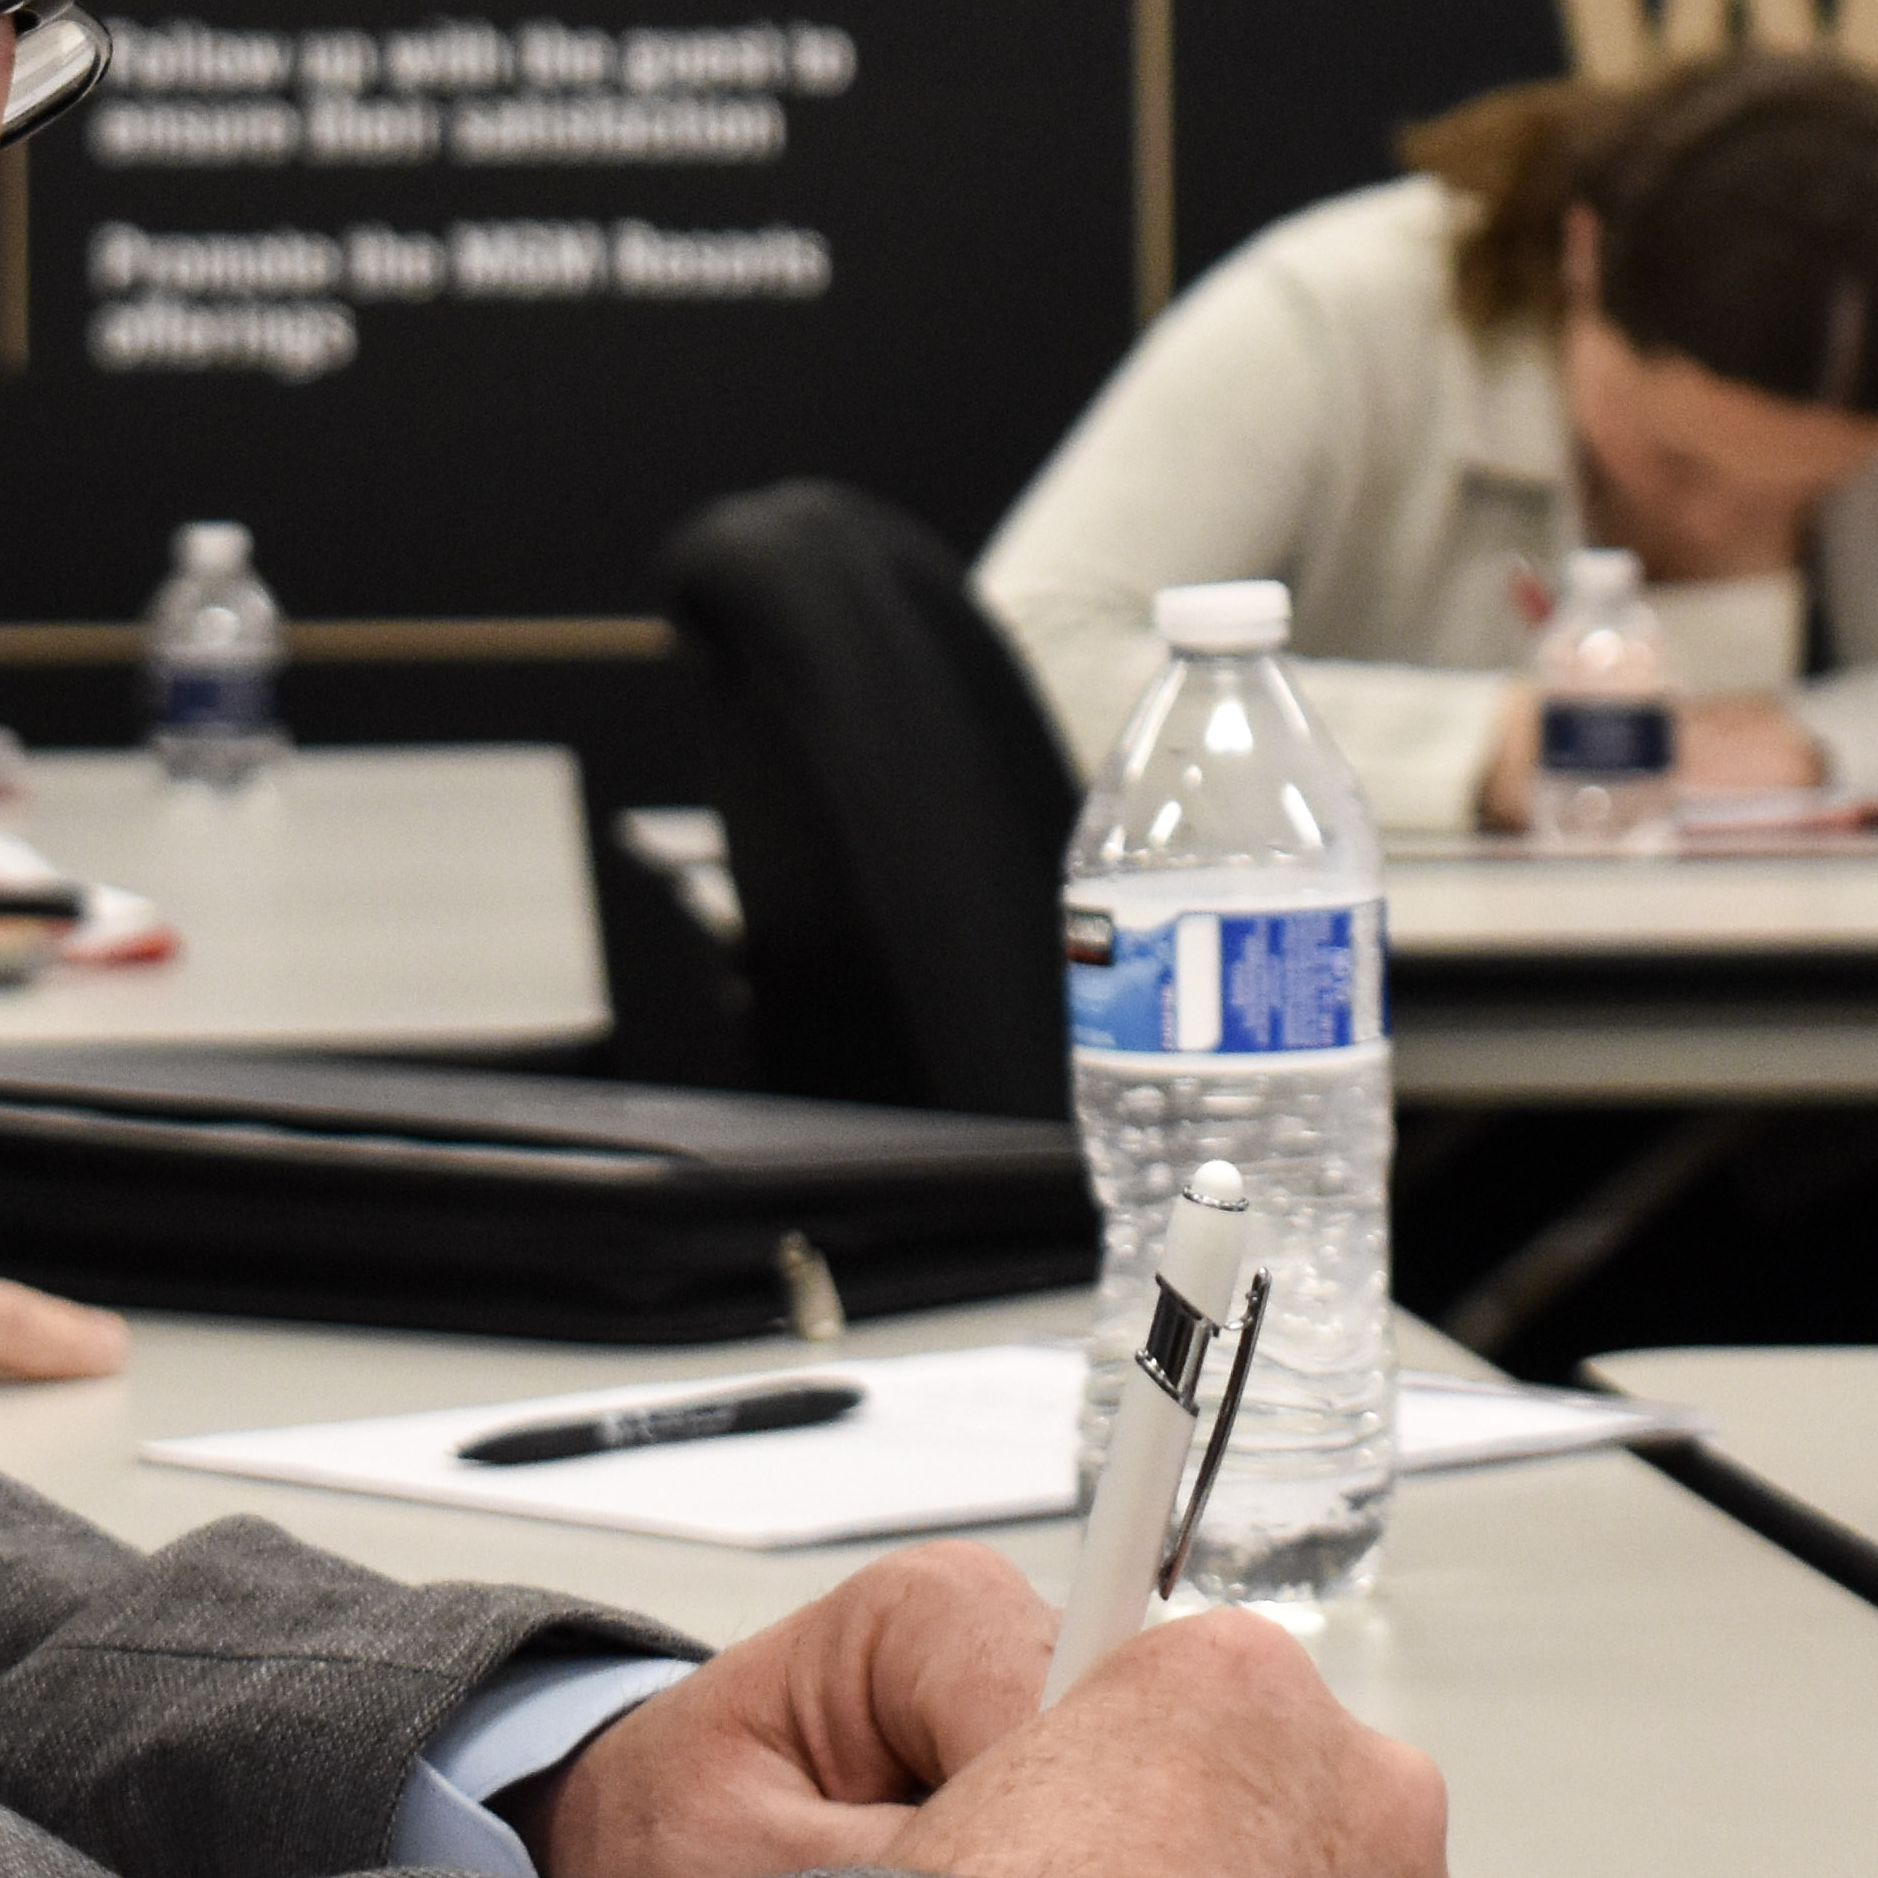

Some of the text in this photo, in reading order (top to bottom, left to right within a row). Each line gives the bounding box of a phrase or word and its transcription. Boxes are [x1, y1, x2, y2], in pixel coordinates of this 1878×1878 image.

[299, 30, 379, 102] up
[384, 22, 515, 88] with
[520, 22, 616, 88] the
[621, 22, 786, 102] guest
[792, 22, 854, 88] to
[452, 95, 784, 159] satisfaction
[96, 225, 826, 291] Promote the MGM Resorts
[97, 300, 354, 378] offerings
